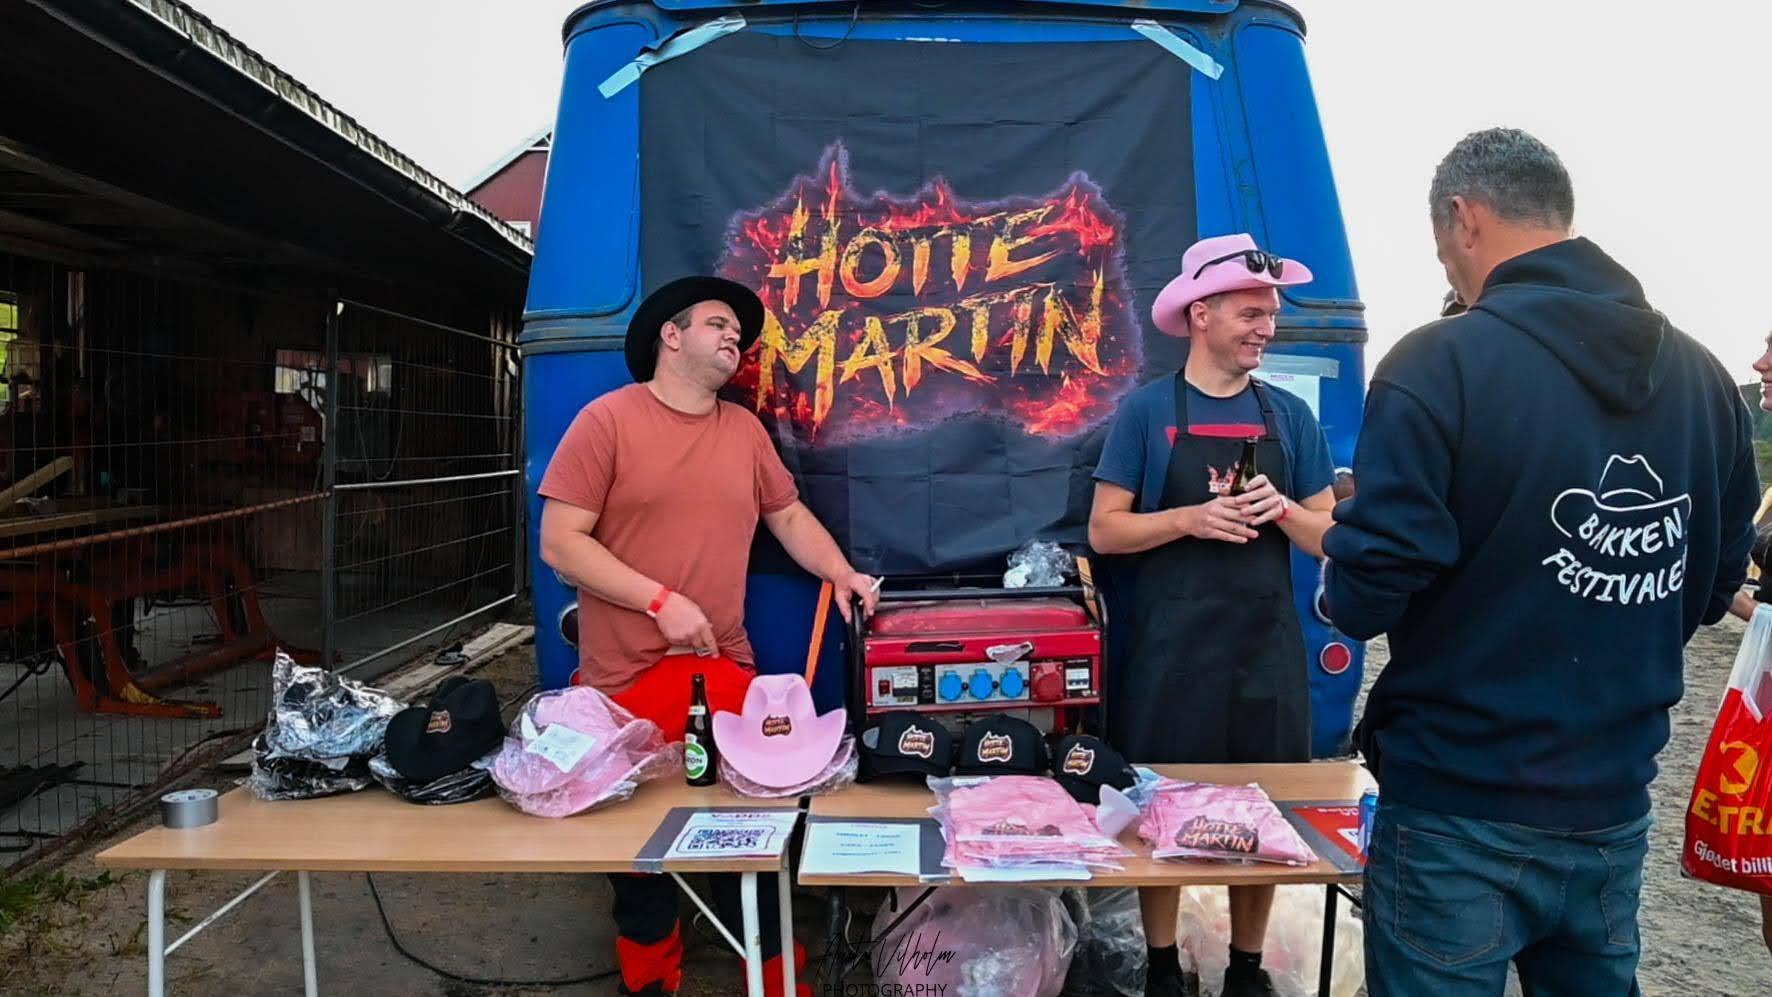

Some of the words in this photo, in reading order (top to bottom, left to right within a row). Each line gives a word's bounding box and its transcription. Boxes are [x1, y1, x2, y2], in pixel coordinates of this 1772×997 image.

[766, 195, 1063, 314] HOTTE
[757, 267, 1107, 432] MARTIN
[1578, 507, 1683, 558] BAKKEN
[1541, 547, 1684, 605] FESTIVALE
[1191, 817, 1247, 835] HOTTE
[1691, 789, 1772, 836] ETR
[1182, 832, 1254, 853] MARTIN
[1741, 856, 1772, 874] billi
